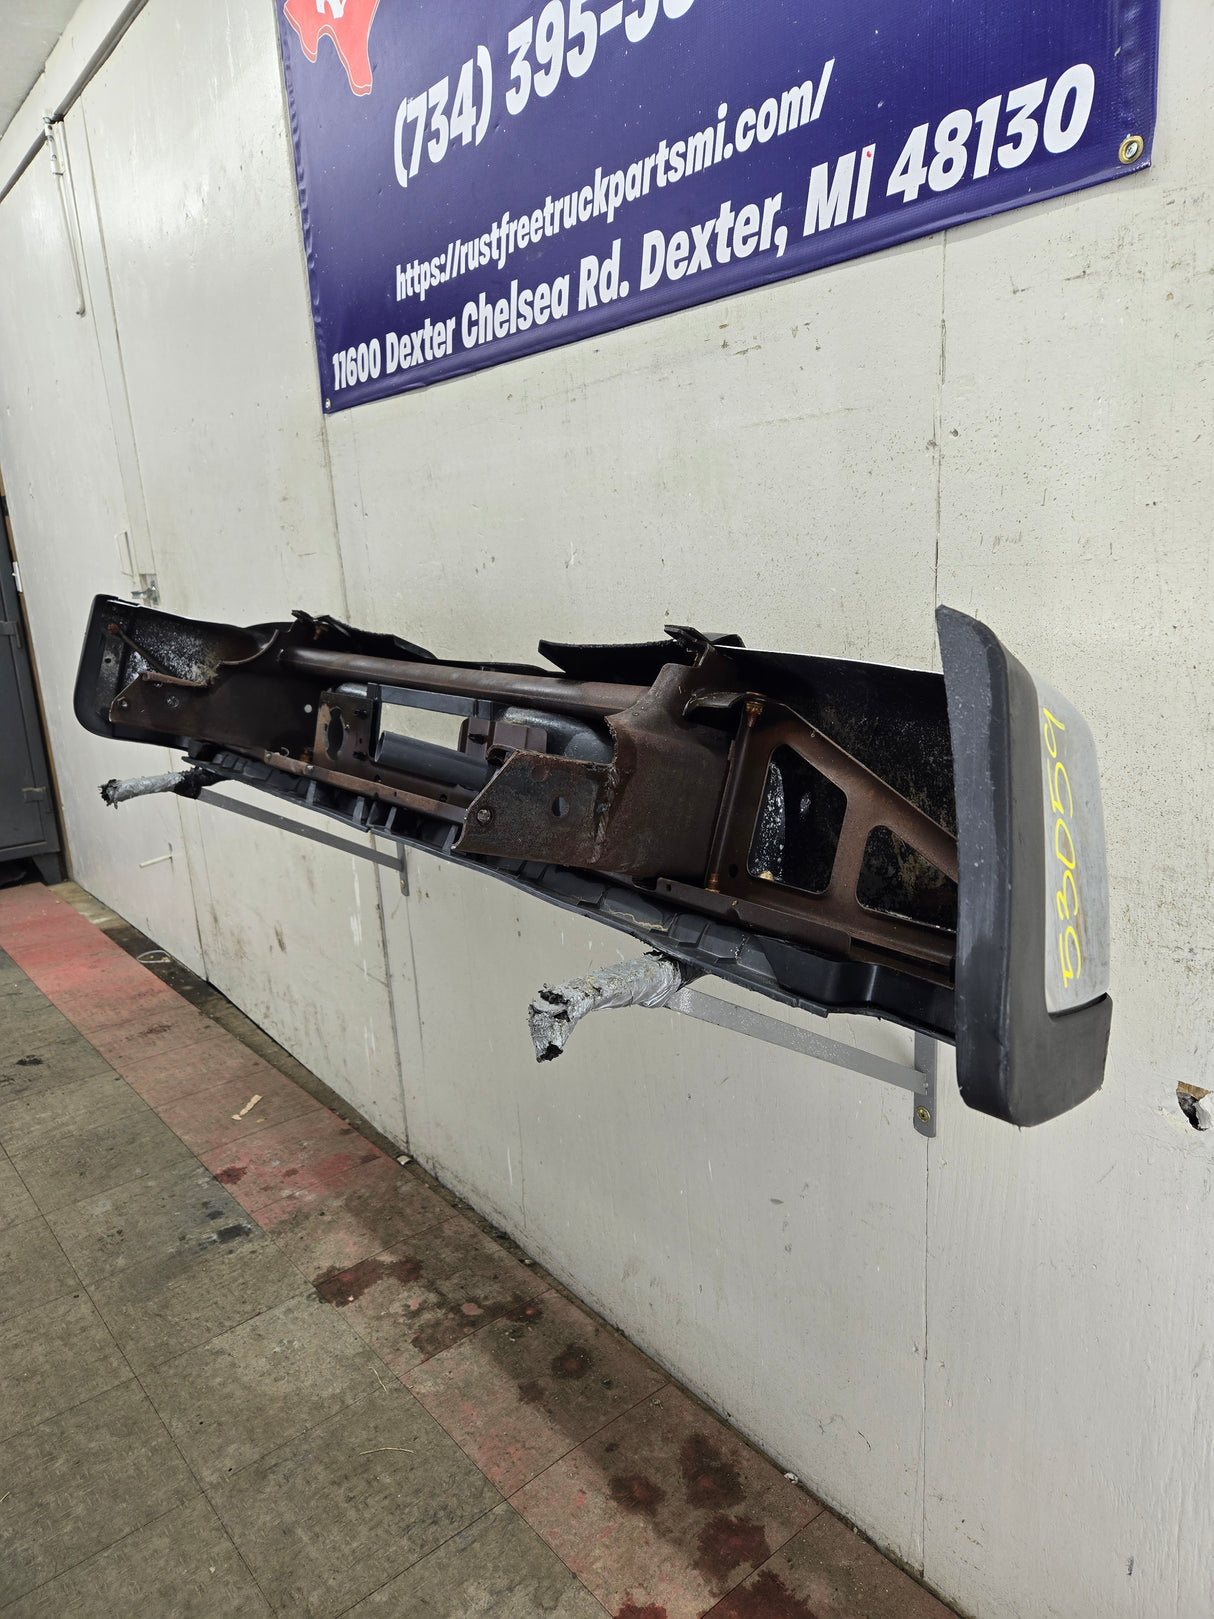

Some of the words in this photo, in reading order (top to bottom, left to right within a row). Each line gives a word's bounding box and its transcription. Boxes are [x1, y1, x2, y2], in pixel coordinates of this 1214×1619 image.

[393, 44, 493, 188] (734)
[505, 0, 697, 116] 395-
[396, 58, 836, 302] https://rustfreetruckpartsmi.com/
[332, 338, 381, 391] 11600
[385, 316, 456, 374] Dexter
[461, 274, 570, 349] Chelsea
[577, 238, 630, 312] Rd.
[639, 191, 788, 291] Dexter,
[802, 143, 876, 237] MI
[886, 63, 1095, 203] 48130
[1042, 708, 1081, 988] 53059
